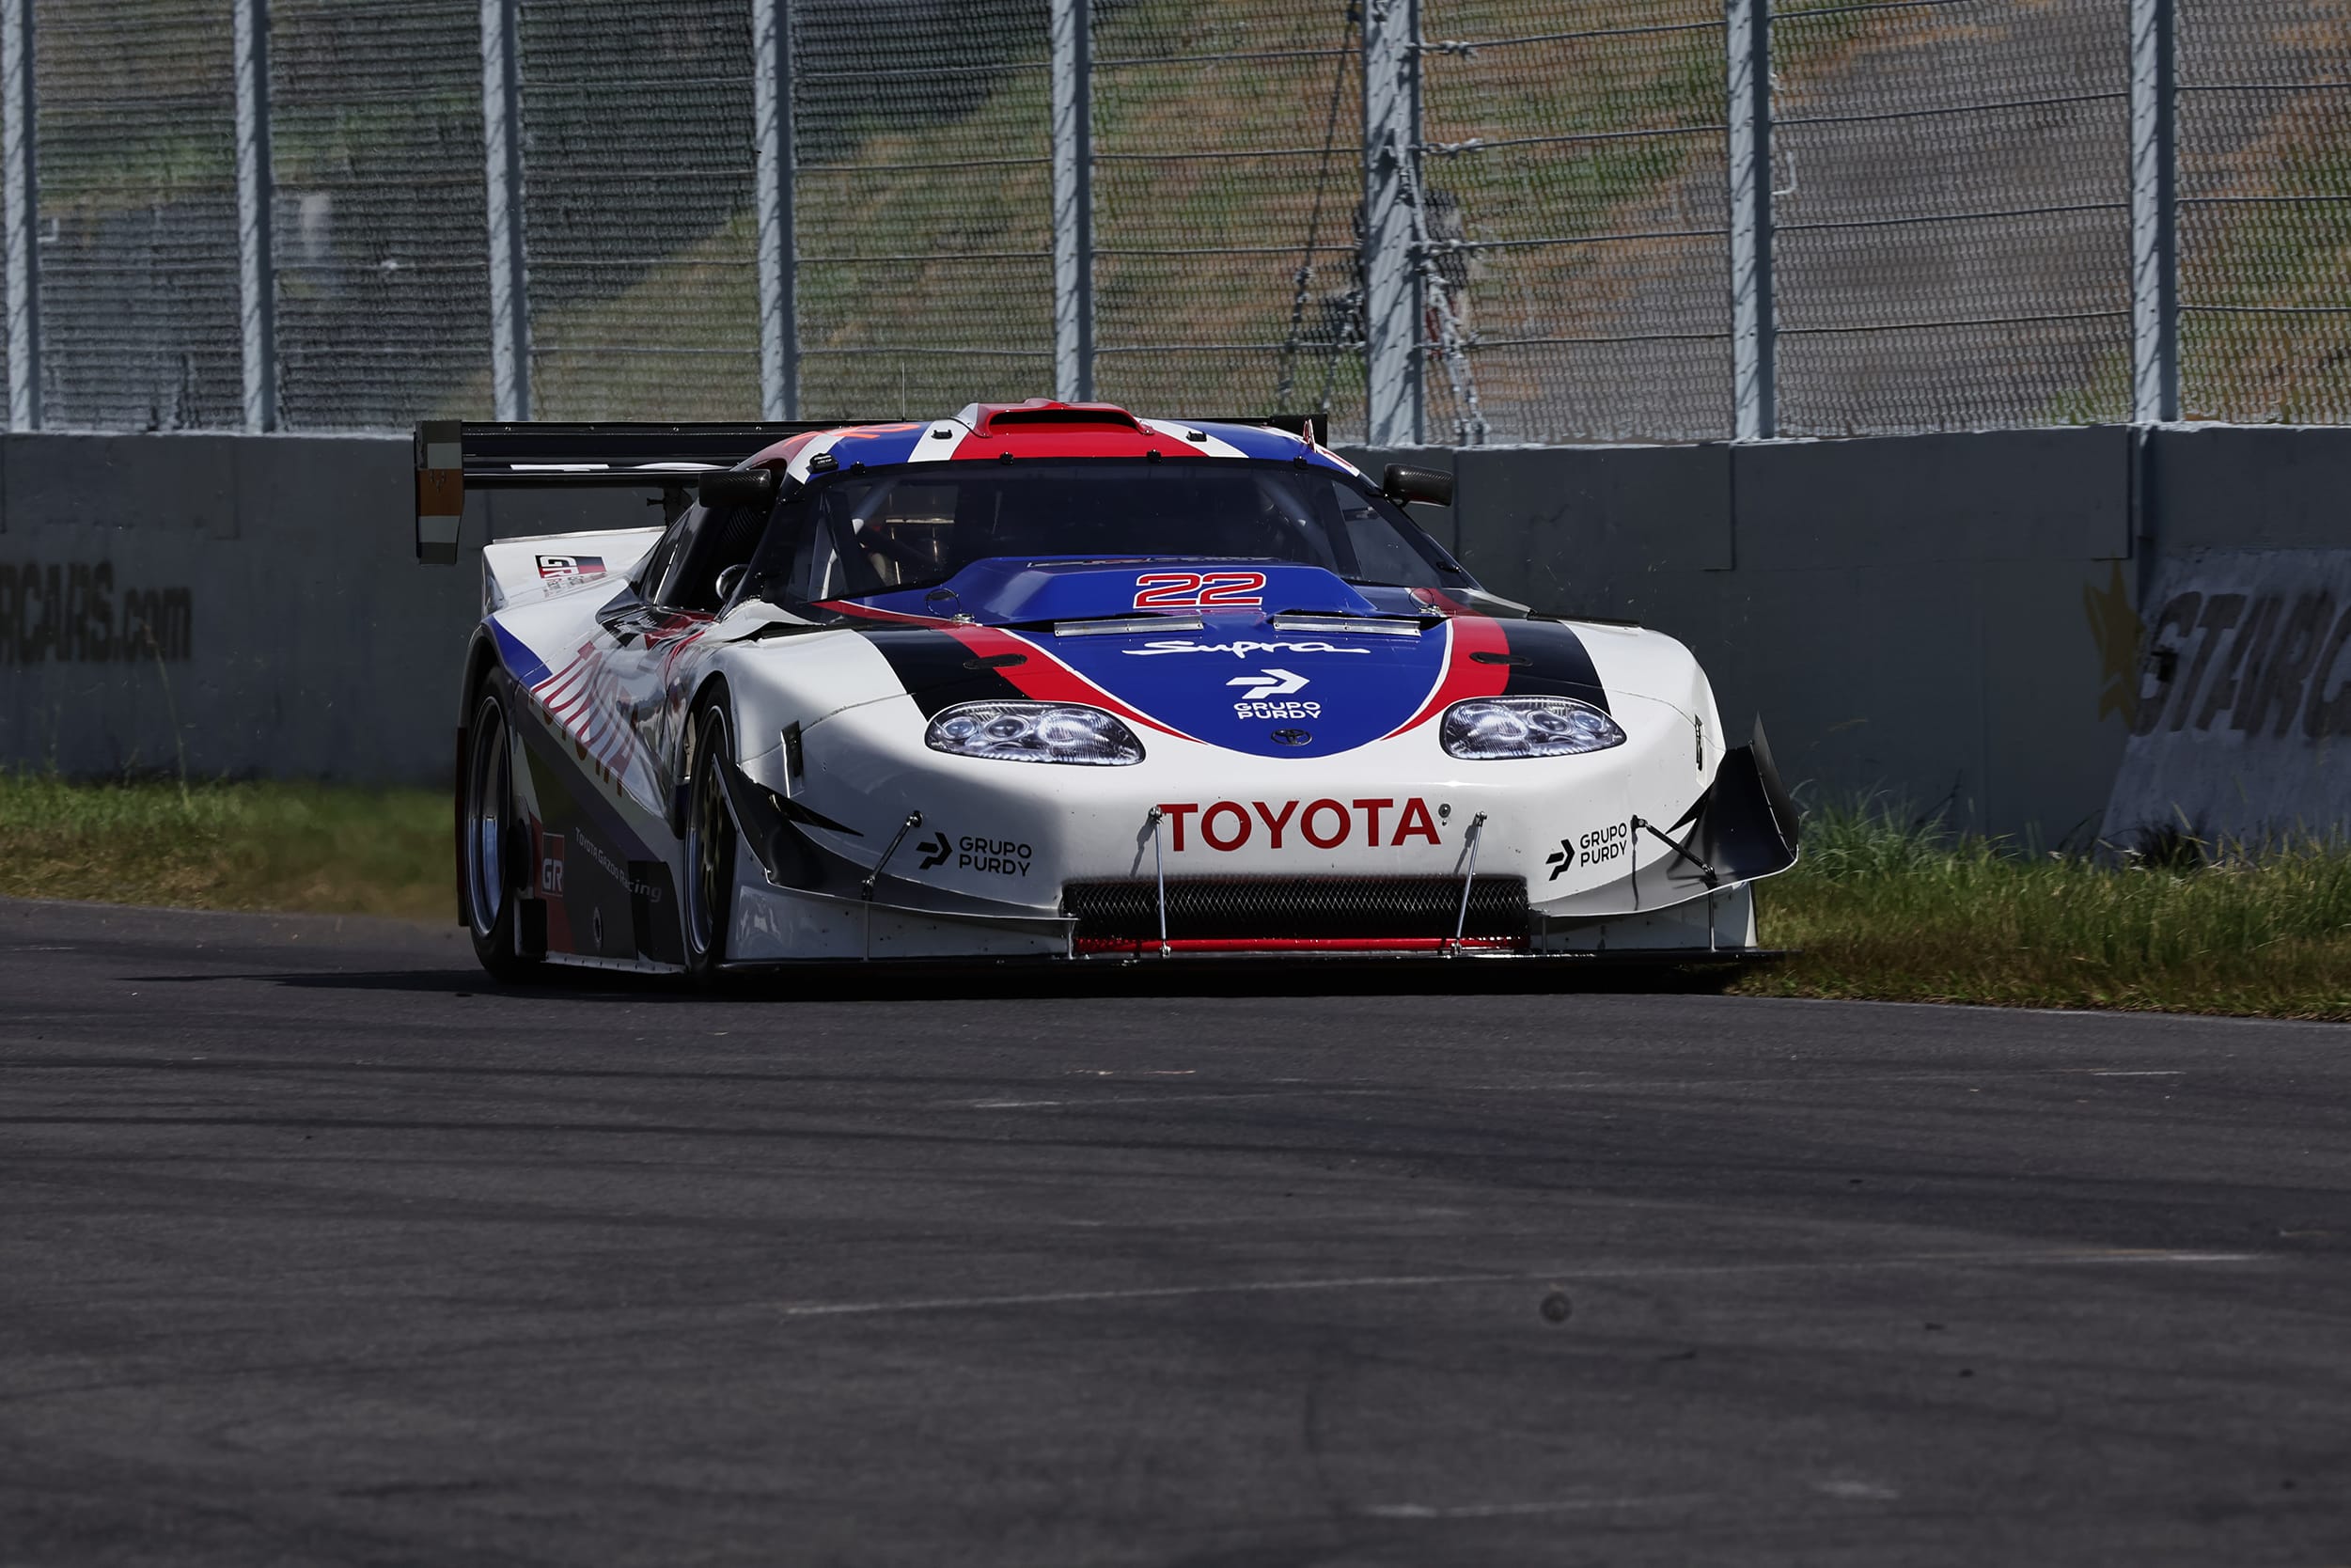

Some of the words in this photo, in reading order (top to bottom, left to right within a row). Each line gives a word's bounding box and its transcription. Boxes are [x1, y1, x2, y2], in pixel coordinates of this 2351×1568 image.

[540, 556, 580, 577] GR
[1133, 572, 1266, 609] 22
[1121, 640, 1371, 658] Supra
[1233, 701, 1320, 712] GRUPO
[1238, 709, 1321, 719] PURDY
[1157, 797, 1441, 852] TOYOTA
[1580, 823, 1626, 849] GRUPO
[959, 836, 1032, 859] GRUPO
[1580, 839, 1626, 868] PURDY
[541, 857, 563, 892] GR
[959, 854, 1030, 877] PURDY
